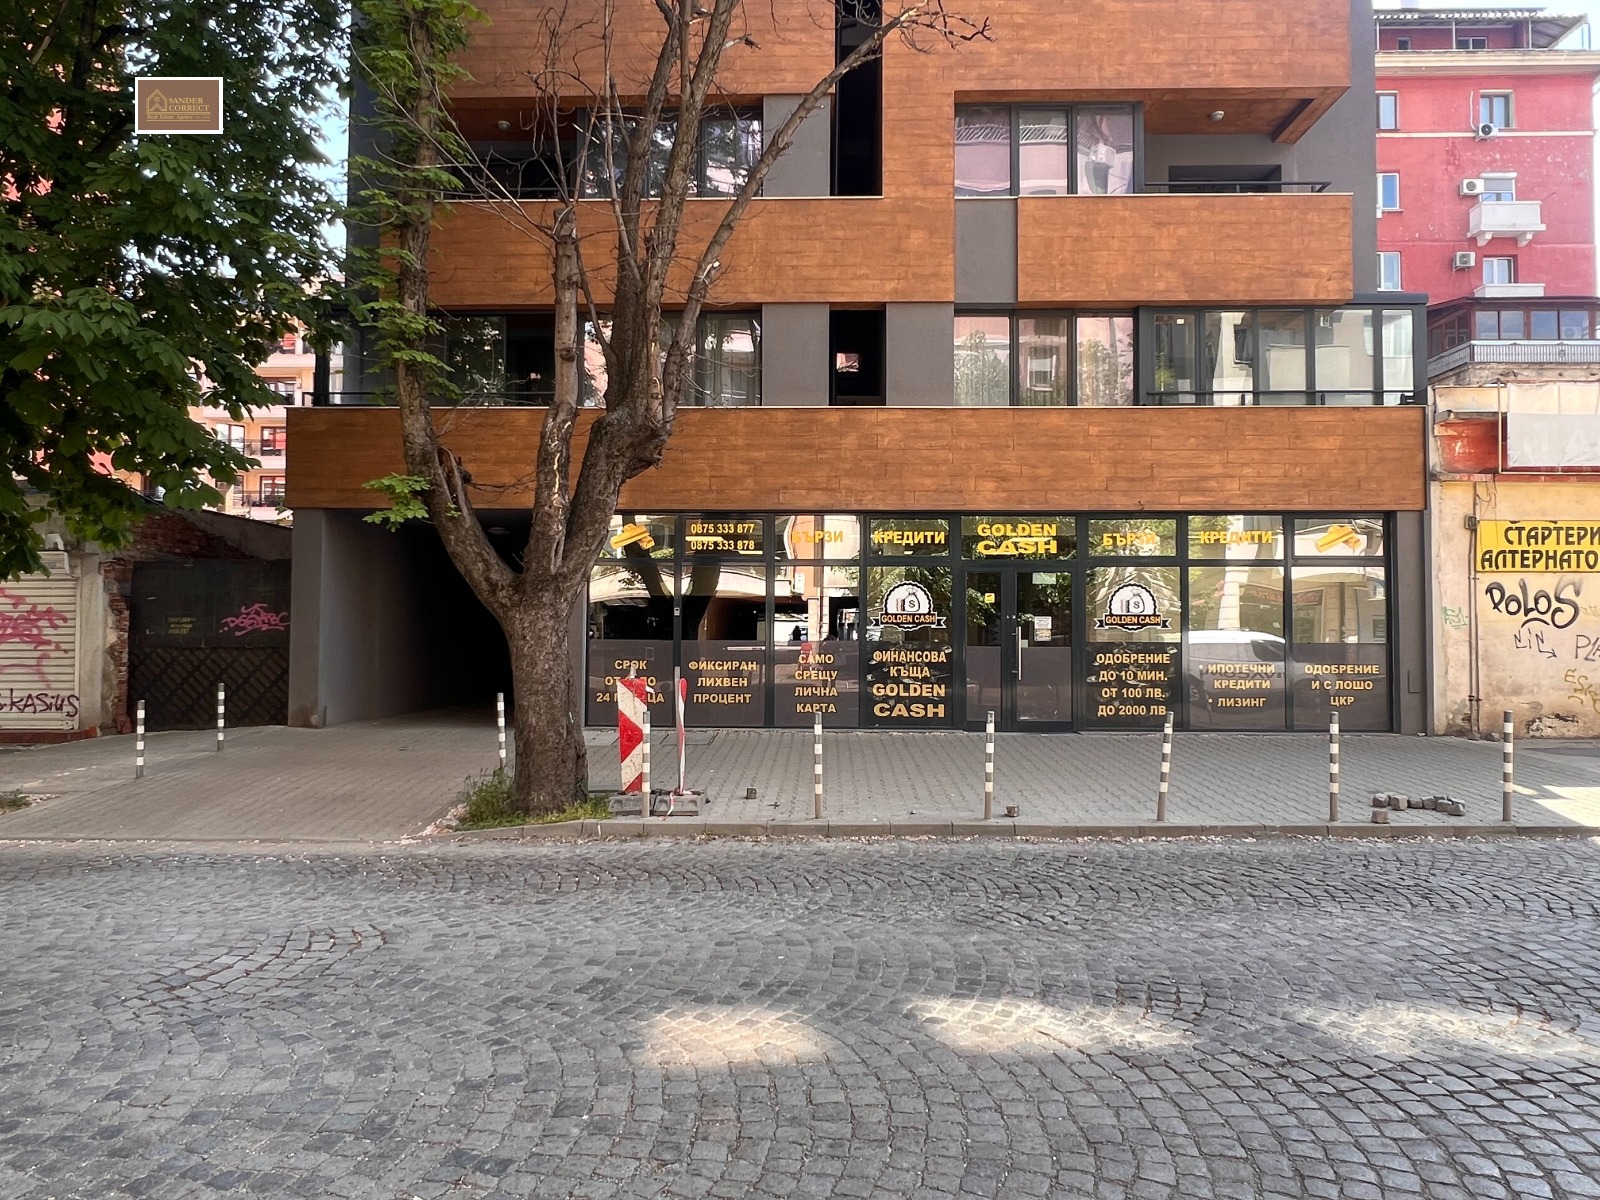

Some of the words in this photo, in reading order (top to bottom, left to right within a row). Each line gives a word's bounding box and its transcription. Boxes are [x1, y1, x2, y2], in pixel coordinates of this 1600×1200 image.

[691, 523, 715, 534] 0875
[717, 523, 735, 534] 333
[737, 523, 755, 534] 877
[977, 523, 1057, 537] GOLDEN
[791, 531, 843, 544] БЪРЗИ
[874, 532, 945, 546] КРЕДИТИ
[1102, 532, 1156, 547] БЪРЗИ
[1200, 531, 1273, 546] КРЕДИТИ
[1504, 526, 1600, 547] СТАРТЕРИ
[691, 540, 715, 550] 0875
[717, 540, 735, 550] 333
[737, 540, 755, 550] 878
[977, 540, 1057, 554] CASH
[881, 614, 913, 623] GOLDEN
[914, 614, 936, 623] CASH
[1106, 615, 1138, 624] GOLDEN
[1138, 615, 1160, 624] CASH
[798, 654, 834, 664] САМО
[873, 651, 946, 663] ФИНАНСОВА
[1096, 653, 1170, 666] ОДОБРЕНИЕ
[614, 660, 647, 669] СРОК
[689, 661, 757, 671] ФИКСИРАН
[1208, 663, 1274, 673] ИПОТЕЧНИ
[1304, 664, 1380, 676] ОДОБРЕНИЕ
[795, 670, 838, 681] СРЕЩУ
[889, 666, 930, 678] КЪЩА
[1099, 671, 1116, 682] ДО
[1120, 671, 1134, 680] 10
[1136, 671, 1168, 680] МИН.
[697, 677, 748, 687] ЛИХВЕН
[1214, 679, 1271, 690] КРЕДИТИ
[1312, 680, 1320, 690] И
[1324, 680, 1332, 690] С
[1335, 680, 1372, 690] ЛОШО
[795, 687, 838, 696] ЛИЧНА
[873, 684, 945, 697] GOLDEN
[1102, 688, 1118, 698] ОТ
[1122, 688, 1142, 698] 100
[1144, 688, 1165, 698] ЛВ.
[596, 693, 610, 702] 24
[693, 694, 752, 705] ПРОЦЕНТ
[1217, 697, 1266, 706] ЛИЗИНГ
[1330, 696, 1354, 707] ЦКР
[797, 703, 836, 713] КАРТА
[874, 704, 945, 718] CASH
[1098, 706, 1116, 717] ДО
[1118, 706, 1147, 716] 2000
